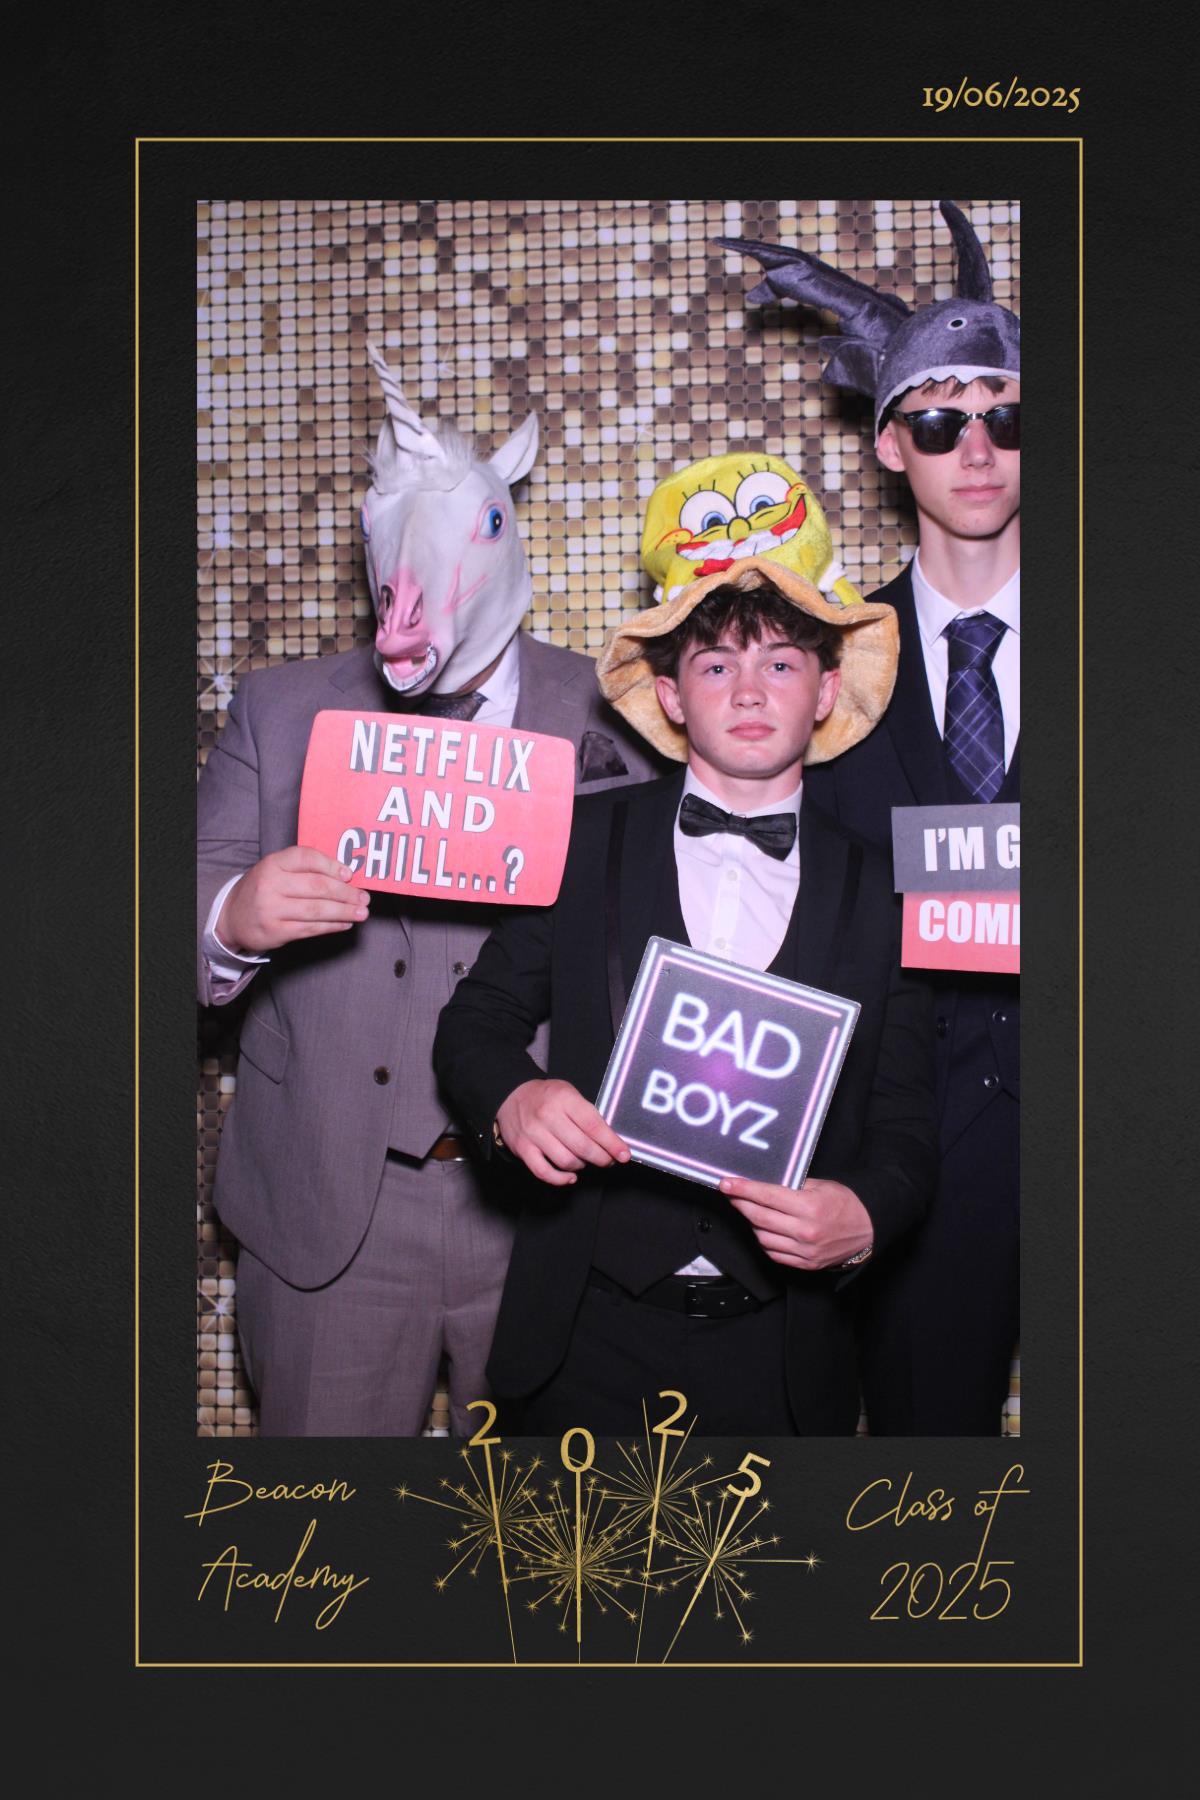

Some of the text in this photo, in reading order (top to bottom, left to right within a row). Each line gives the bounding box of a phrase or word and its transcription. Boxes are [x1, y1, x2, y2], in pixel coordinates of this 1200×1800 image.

[349, 719, 536, 793] NETFLIX
[376, 786, 496, 833] AND
[923, 826, 986, 872] I'M
[662, 991, 802, 1080] BAD
[641, 1068, 780, 1151] BOYZ
